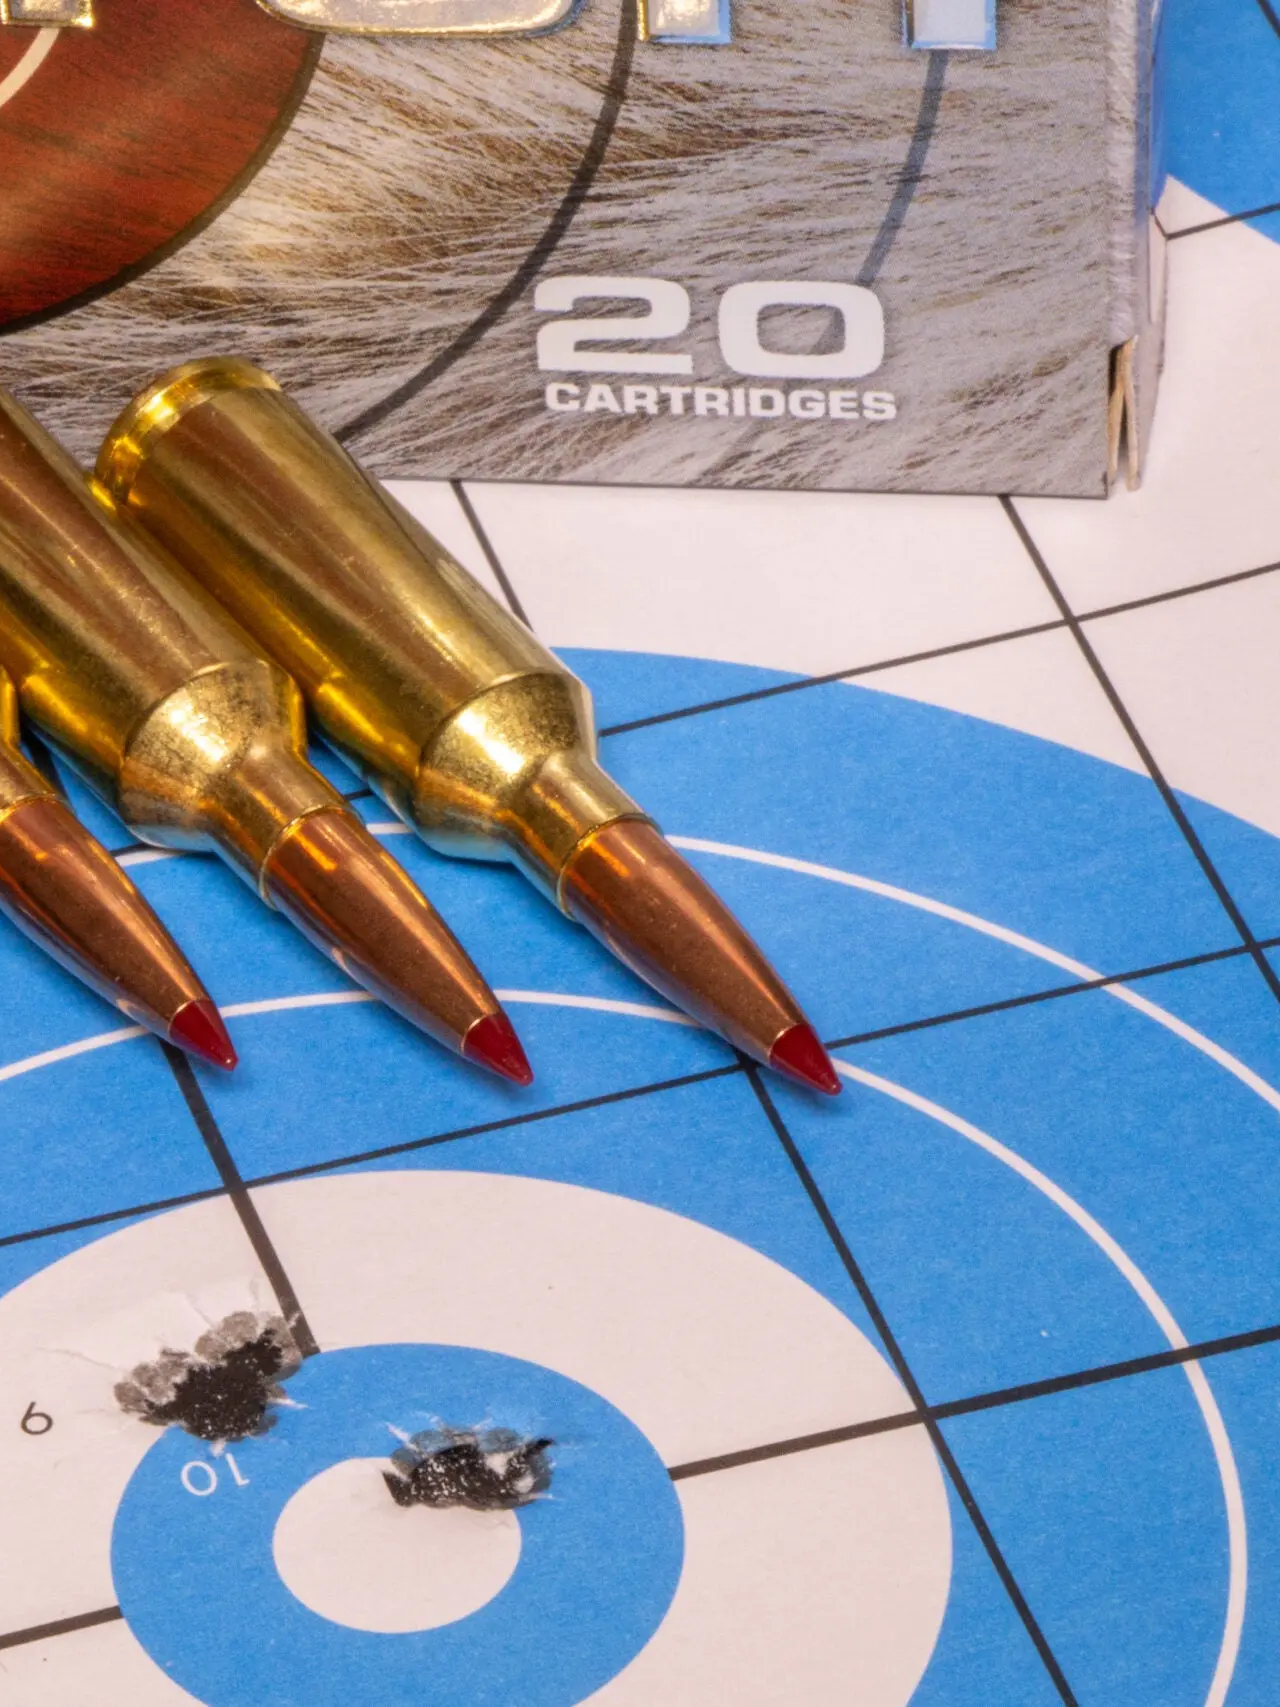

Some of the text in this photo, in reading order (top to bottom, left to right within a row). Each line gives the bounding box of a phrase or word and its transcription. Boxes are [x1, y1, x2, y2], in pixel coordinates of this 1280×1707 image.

[533, 274, 886, 380] 20
[545, 382, 898, 421] CARTRIDGES
[180, 1452, 251, 1497] 10
